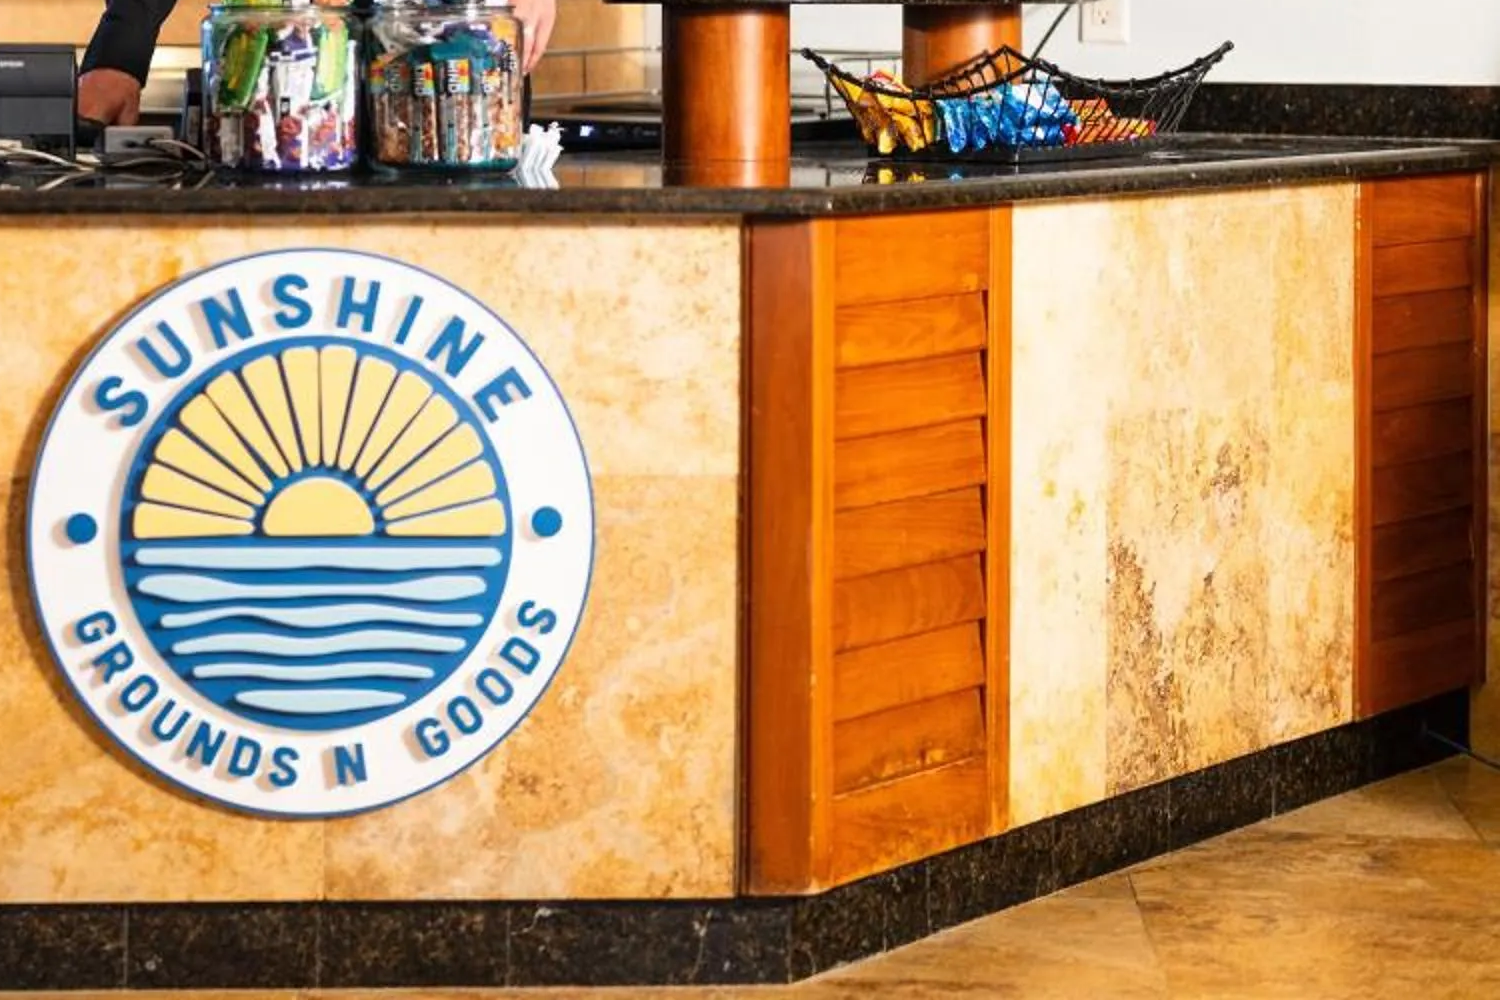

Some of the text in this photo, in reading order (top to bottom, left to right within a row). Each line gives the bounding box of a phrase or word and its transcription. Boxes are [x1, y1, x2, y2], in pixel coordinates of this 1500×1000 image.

[95, 274, 533, 428] SUNSHINE
[76, 599, 557, 787] GROUNDS N GOODS
